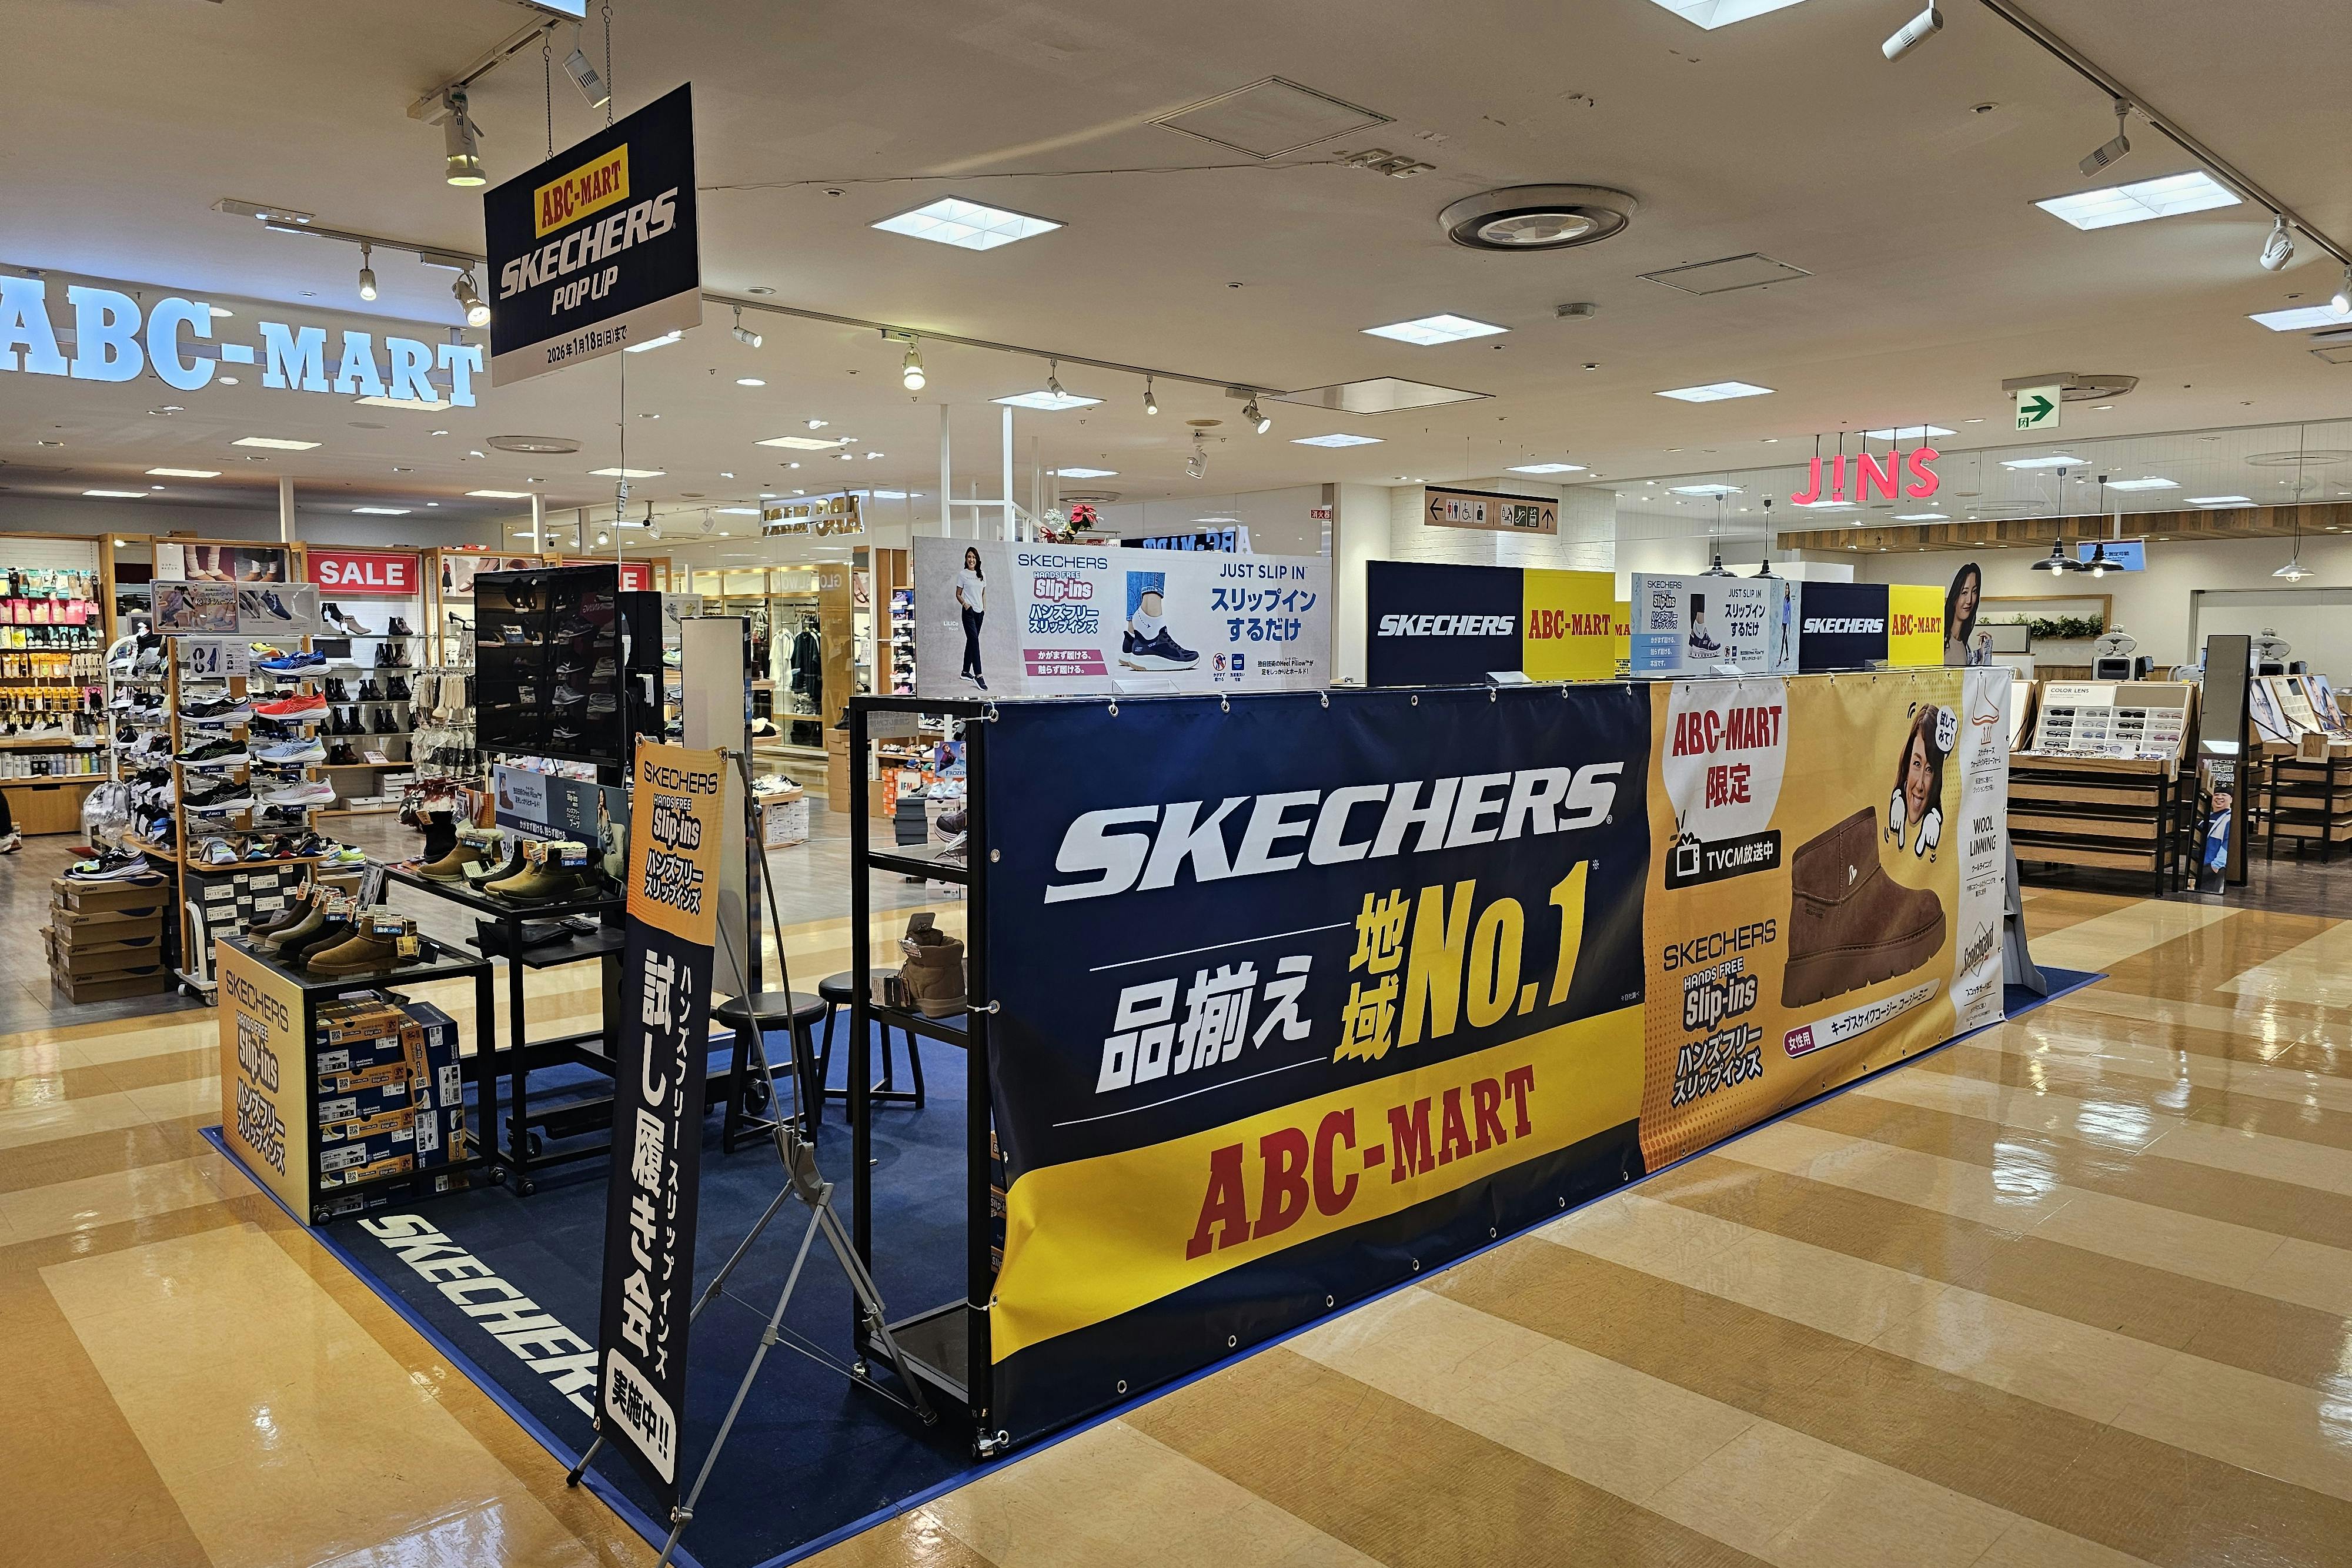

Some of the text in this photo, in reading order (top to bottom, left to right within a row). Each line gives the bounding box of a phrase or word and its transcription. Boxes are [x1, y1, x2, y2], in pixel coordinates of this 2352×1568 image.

[542, 160, 621, 229] ABC-MART
[500, 187, 678, 300] SKECHERS
[551, 266, 618, 316] POP UP
[0, 276, 484, 408] ABC-MART
[547, 325, 627, 365] 2026年1月18日(日)まで
[1311, 509, 1331, 519] 消火器
[319, 561, 405, 586] SALE
[1018, 554, 1108, 570] SKECHERS
[1220, 563, 1254, 578] JUST
[1258, 564, 1287, 579] SLIP
[1035, 579, 1093, 600] Slip-ins
[1211, 587, 1317, 613] スリップイン
[1647, 580, 1682, 589] SKECHERS
[1728, 589, 1742, 597] JUST
[1743, 589, 1755, 598] SLIP
[1029, 604, 1099, 620] ハンズフリー
[1651, 611, 1678, 622] ハンズフリー
[1652, 595, 1676, 609] Slip-ins
[1725, 603, 1766, 618] スリップイン
[1029, 619, 1098, 634] スリップインズ
[1227, 617, 1301, 642] するだけ
[1377, 614, 1516, 636] SKECHERS
[1528, 609, 1611, 640] ABC-MART
[1730, 621, 1759, 637] するだけ
[1803, 617, 1883, 634] SKECHERS
[1892, 613, 1941, 636] ABC-MART
[1672, 706, 1782, 757] ABC-MART
[1940, 711, 1956, 731] 試して
[1938, 729, 1953, 746] みて!
[644, 761, 719, 795] SKECHERS
[1706, 763, 1751, 809] 限定
[653, 794, 691, 810] HANDS FREE
[653, 807, 701, 849] Slip-ins
[1044, 761, 1625, 904] SKECHERS
[1973, 815, 1993, 835] WOOL
[1706, 841, 1773, 871] TVCM放送中
[1970, 834, 1996, 857] LINNING
[646, 850, 704, 886] ハンズフリー
[644, 877, 701, 915] スリップインズ
[1663, 919, 1777, 971] SKECHERS
[1960, 921, 1994, 978] Scotchgard
[1096, 955, 1313, 1095] 品揃え
[1398, 861, 1589, 1050] No.1
[1683, 956, 1743, 991] HANDS FREE
[226, 969, 289, 1033] SKECHERS
[1684, 975, 1757, 1029] Slip-ins
[236, 1009, 269, 1042] HANDS FREE
[1788, 1031, 1811, 1051] 女性用
[238, 1032, 279, 1093] Slip-ins
[1676, 1023, 1763, 1079] ハンズフリー
[1672, 1049, 1763, 1108] スリップインズ
[237, 1076, 286, 1139] ハンズフリー
[238, 1114, 286, 1176] スリップインズ
[1185, 1065, 1535, 1261] ABC-MART
[611, 1369, 669, 1461] 実施中!!
